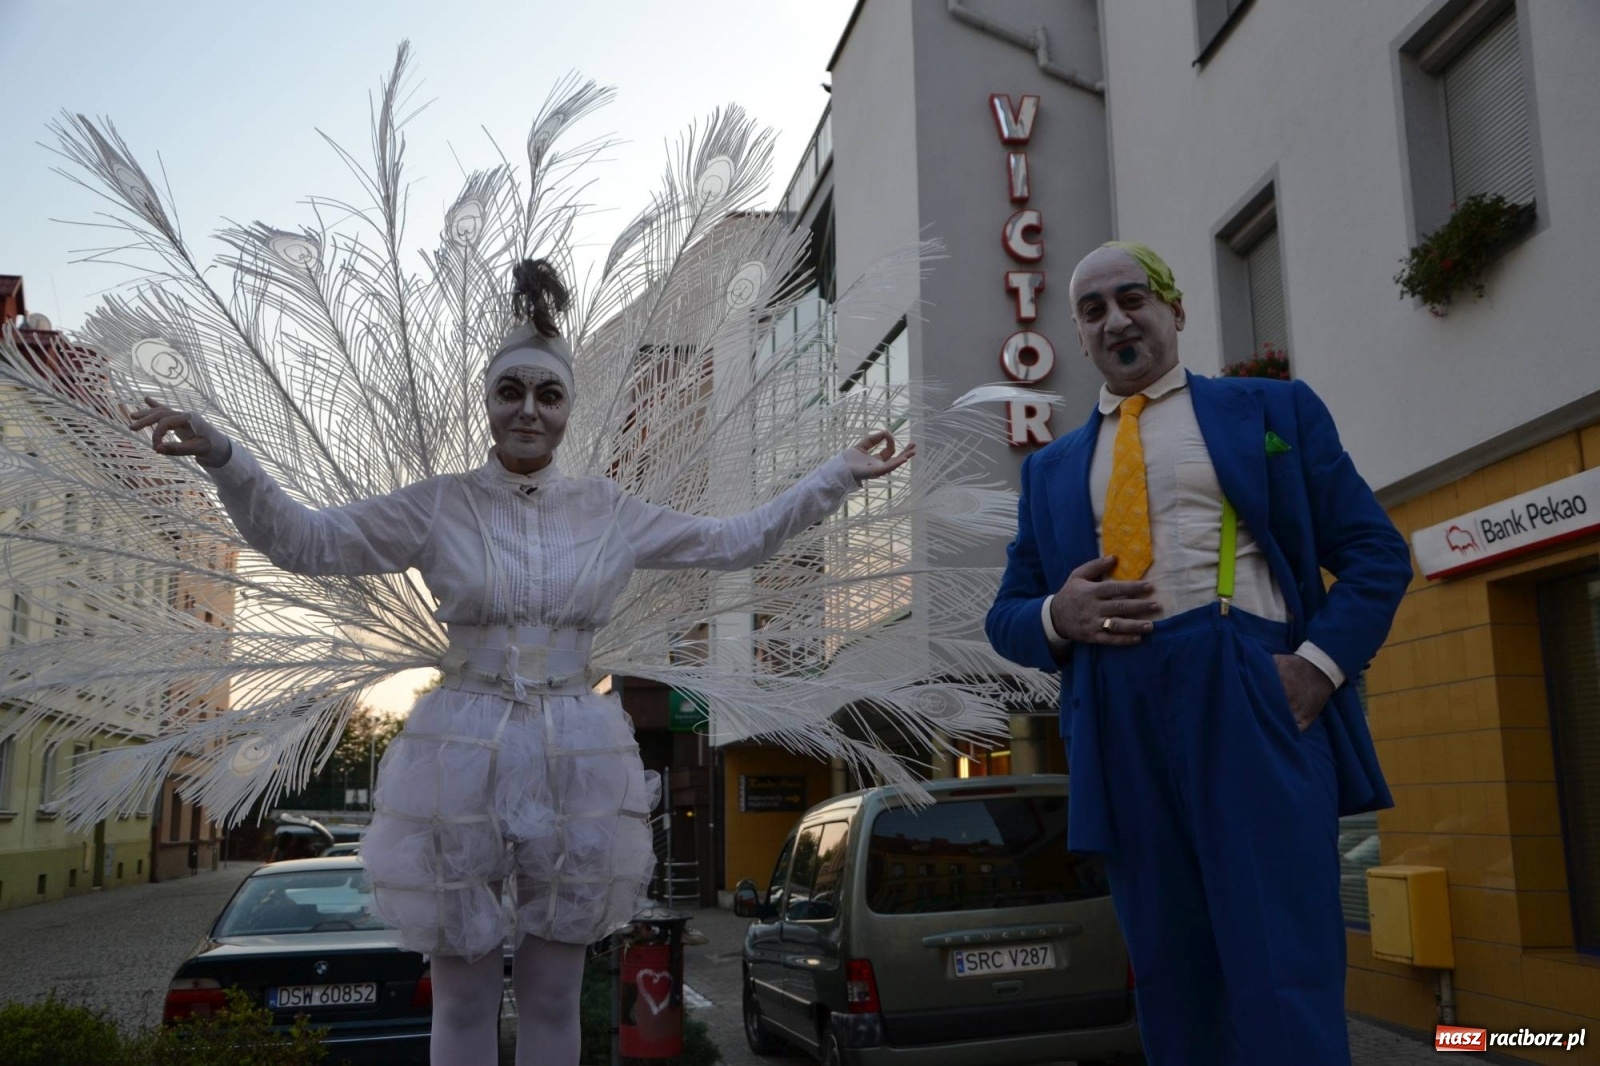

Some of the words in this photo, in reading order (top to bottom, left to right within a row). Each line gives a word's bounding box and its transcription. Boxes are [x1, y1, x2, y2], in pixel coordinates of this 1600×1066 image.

[989, 93, 1056, 448] VICTOR
[1480, 509, 1528, 544] Bank
[1525, 495, 1587, 529] Pekao
[965, 951, 1003, 971] SRC
[1008, 947, 1048, 967] V287
[279, 986, 314, 1006] DSW
[319, 983, 375, 1004] 60852
